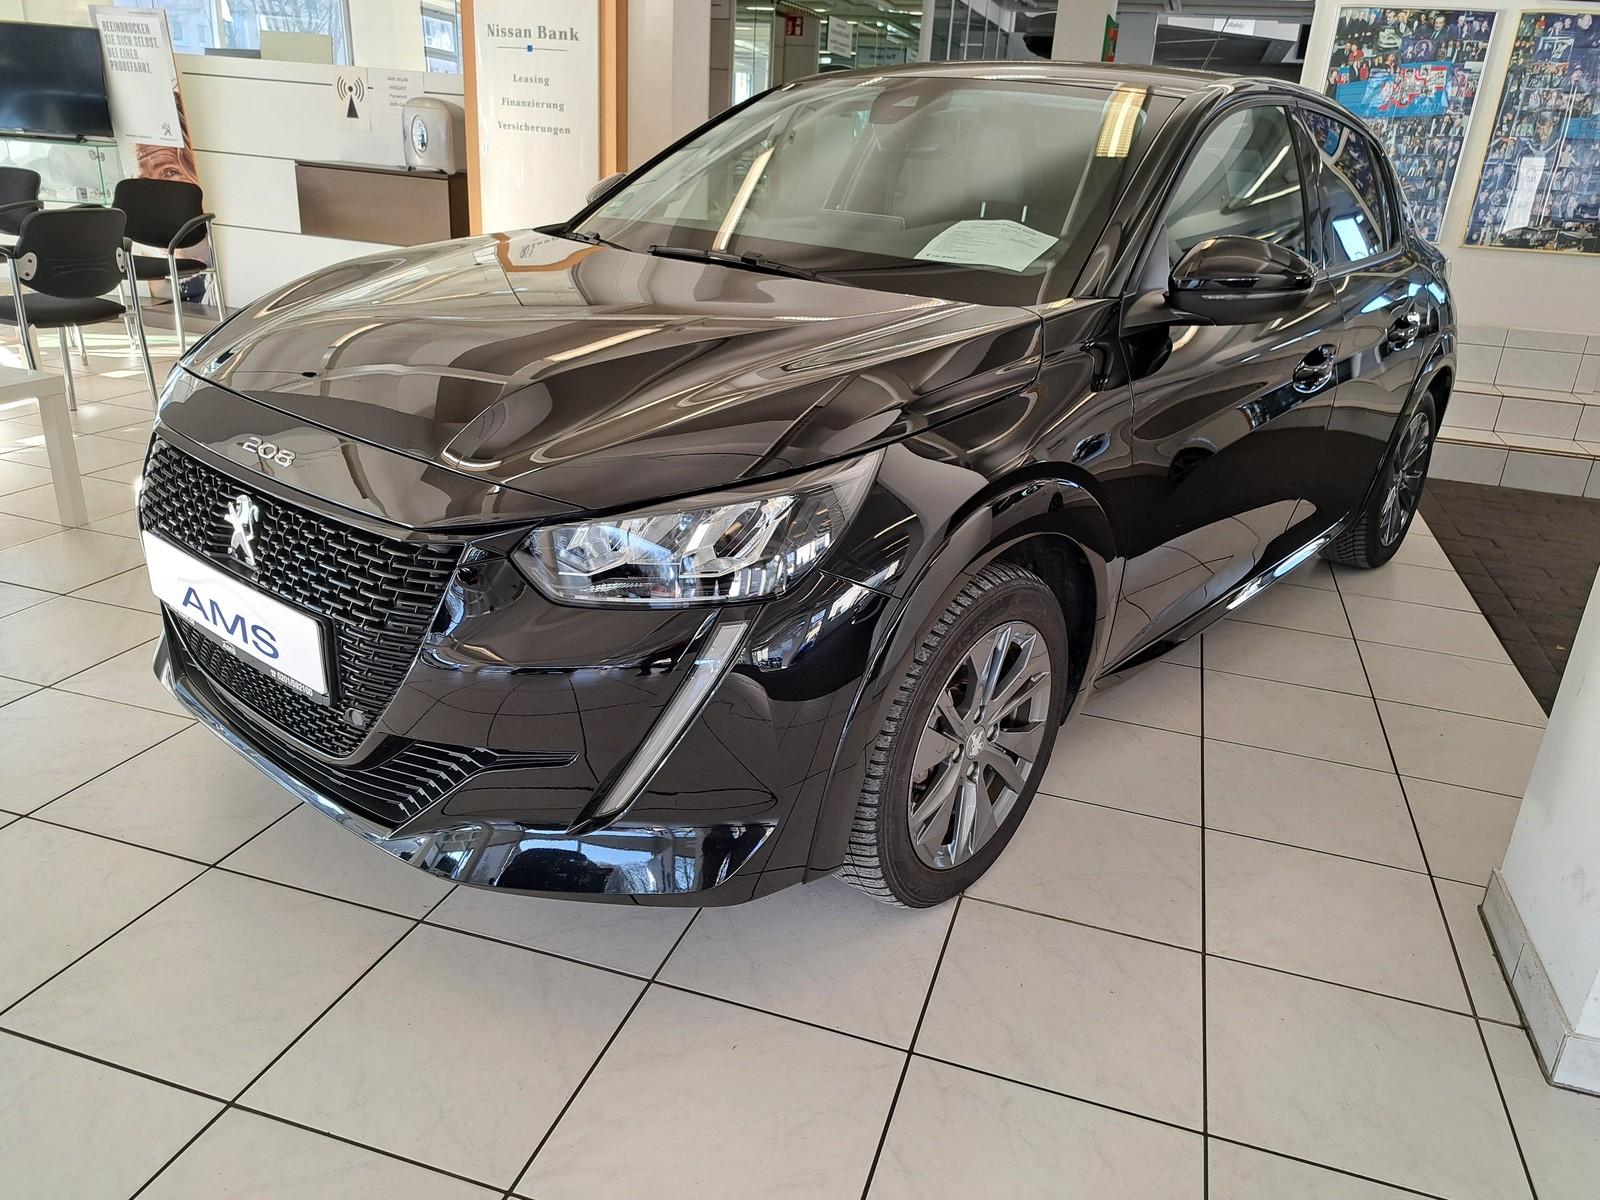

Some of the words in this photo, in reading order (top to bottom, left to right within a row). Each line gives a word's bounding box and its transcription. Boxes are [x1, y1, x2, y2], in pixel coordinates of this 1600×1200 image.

[487, 24, 532, 38] Nissan
[537, 26, 580, 41] Bank
[104, 34, 116, 46] SIE
[117, 35, 133, 47] SICH
[107, 47, 119, 58] BEI
[119, 48, 139, 60] EINER
[513, 74, 550, 87] Leasing
[501, 97, 565, 112] Finanzierung
[498, 121, 571, 136] Versicherungen
[242, 436, 296, 468] 208
[182, 586, 280, 659] AMS
